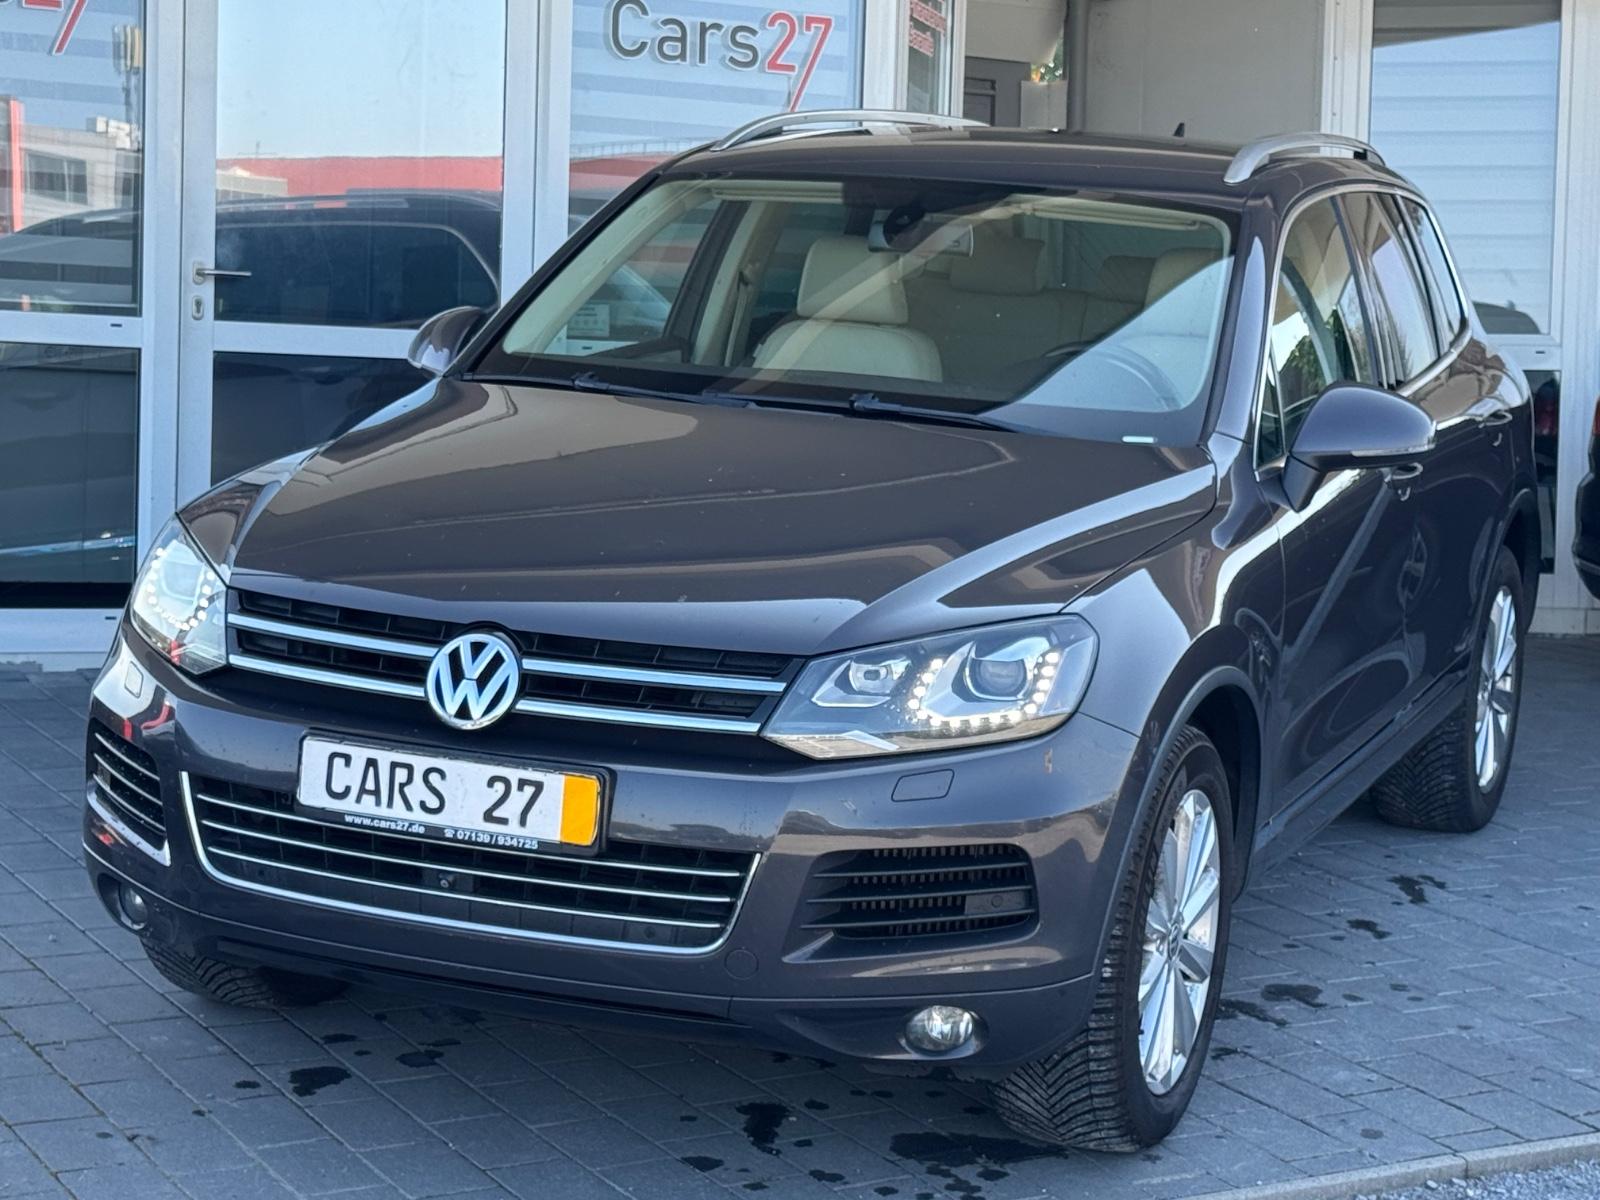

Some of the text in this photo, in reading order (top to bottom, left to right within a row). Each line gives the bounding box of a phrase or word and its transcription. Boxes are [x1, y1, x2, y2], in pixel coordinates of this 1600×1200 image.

[610, 0, 833, 112] Cars27
[428, 634, 518, 728] VW
[324, 752, 545, 828] CARS 27
[344, 814, 426, 834] www.cars27.de
